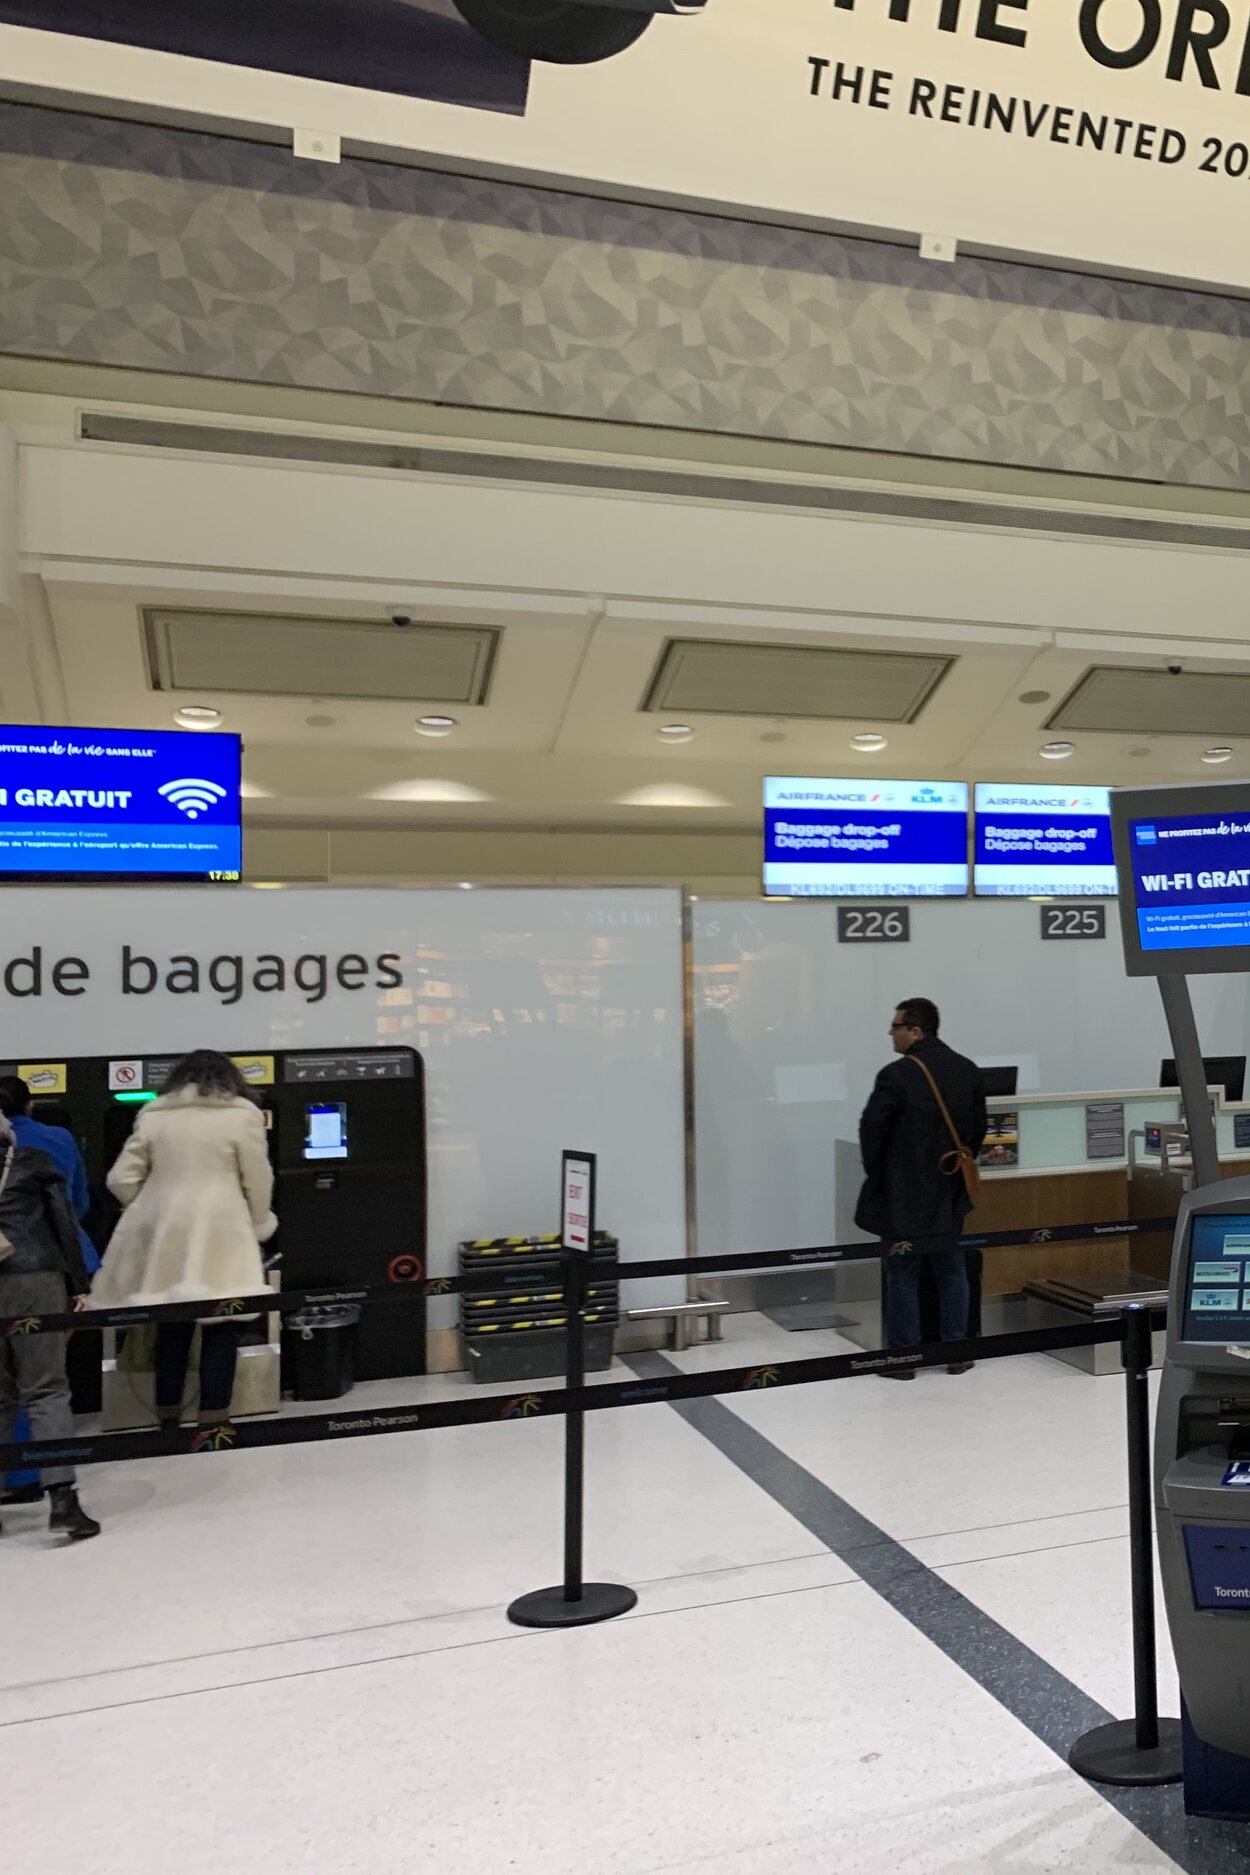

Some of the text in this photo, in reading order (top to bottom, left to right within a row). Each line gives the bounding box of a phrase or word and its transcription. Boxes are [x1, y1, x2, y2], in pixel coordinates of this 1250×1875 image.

[806, 57, 892, 110] THE
[908, 78, 1187, 164] REINVENTED
[48, 740, 66, 755] de
[84, 744, 105, 756] vie
[15, 788, 132, 808] GRATUIT
[774, 822, 901, 837] Baggage drop-off
[985, 826, 1097, 840] Baggage drop-off
[1217, 821, 1230, 835] de
[830, 836, 889, 851] bagages
[1034, 840, 1086, 852] bagages
[1141, 872, 1193, 891] WI-FI
[845, 912, 903, 937] 226
[1048, 911, 1099, 934] 225
[4, 945, 403, 1005] de bagages
[328, 1414, 419, 1431] Toronto Pearson
